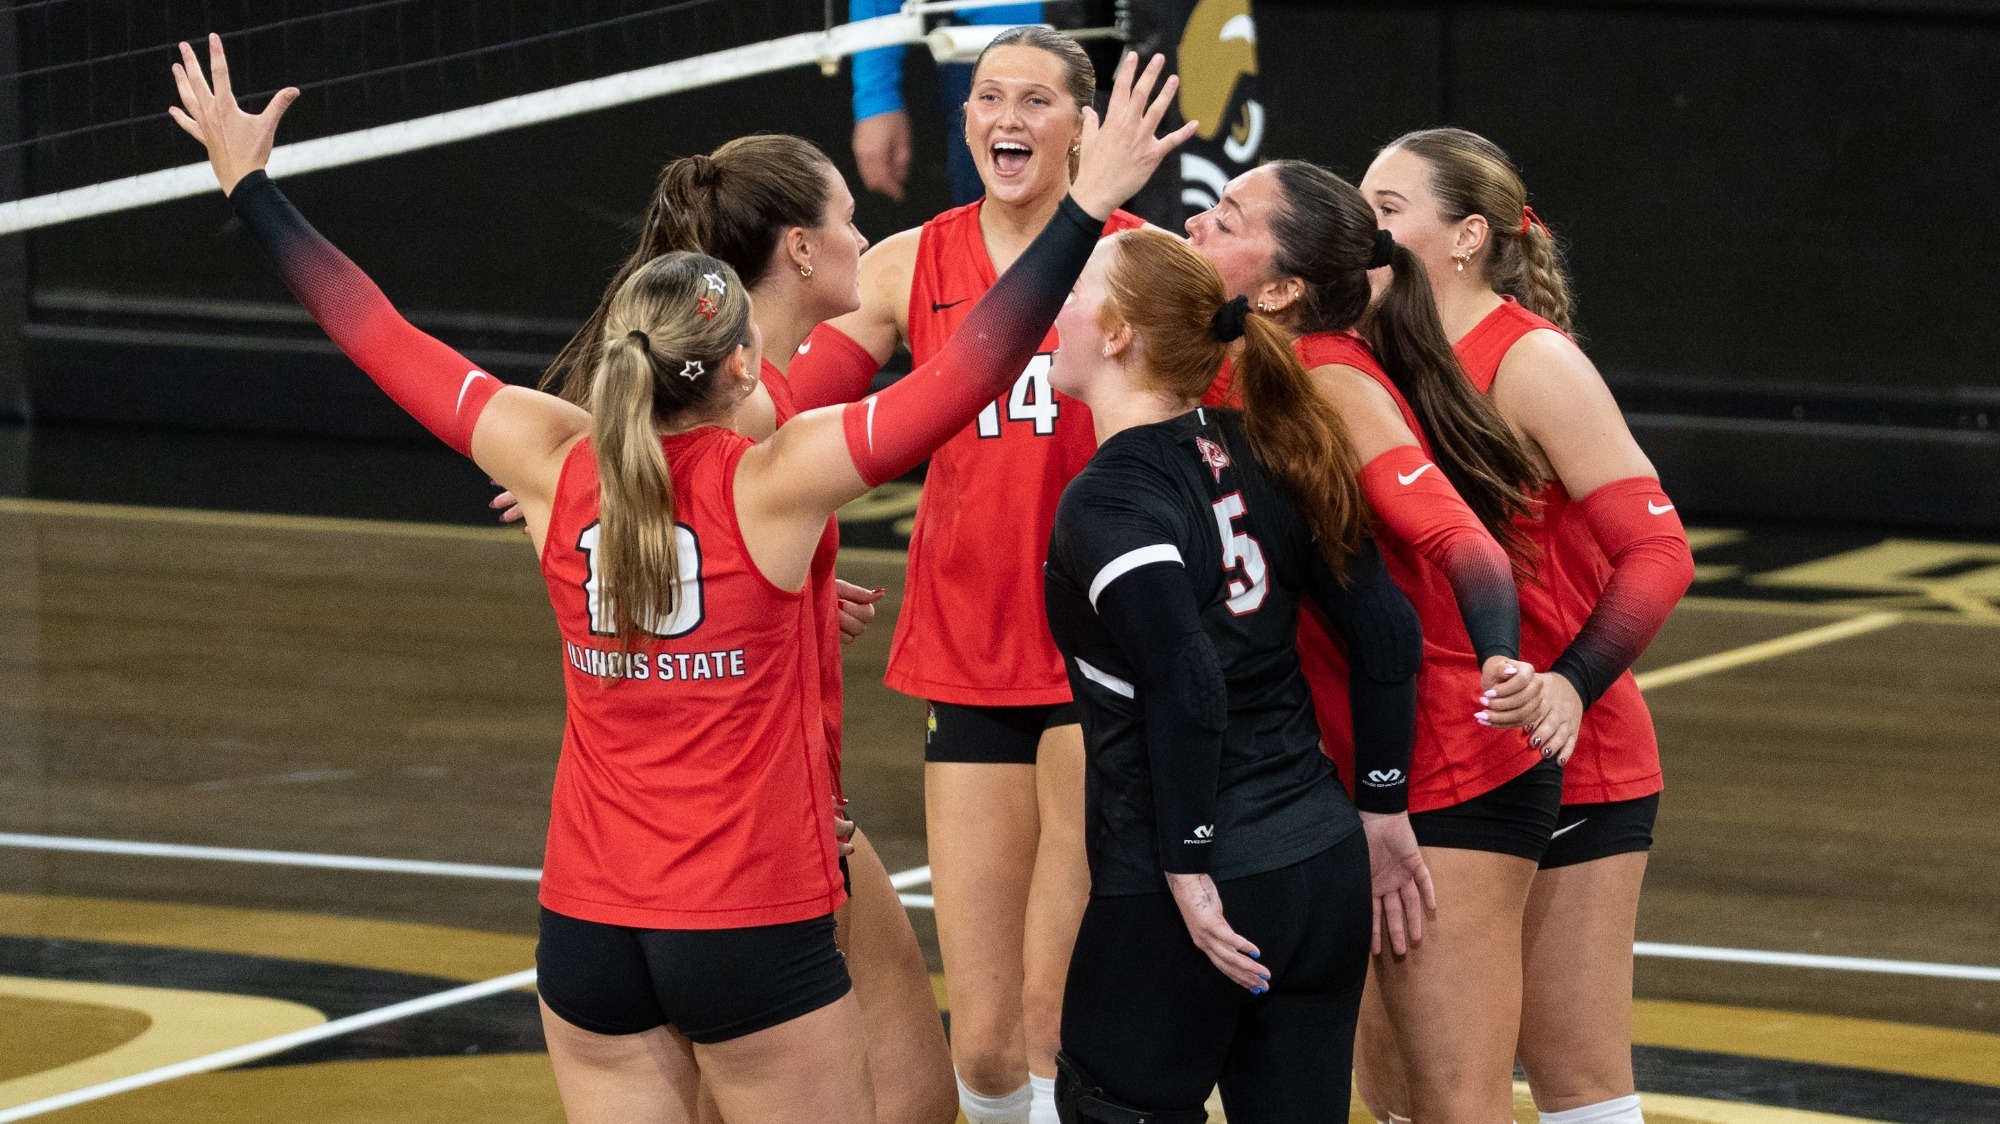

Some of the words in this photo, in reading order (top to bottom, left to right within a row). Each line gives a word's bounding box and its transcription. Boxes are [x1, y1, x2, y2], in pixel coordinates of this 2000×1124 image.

[1212, 489, 1270, 616] 5
[566, 640, 650, 680] ILLINOIS
[656, 649, 746, 681] STATE
